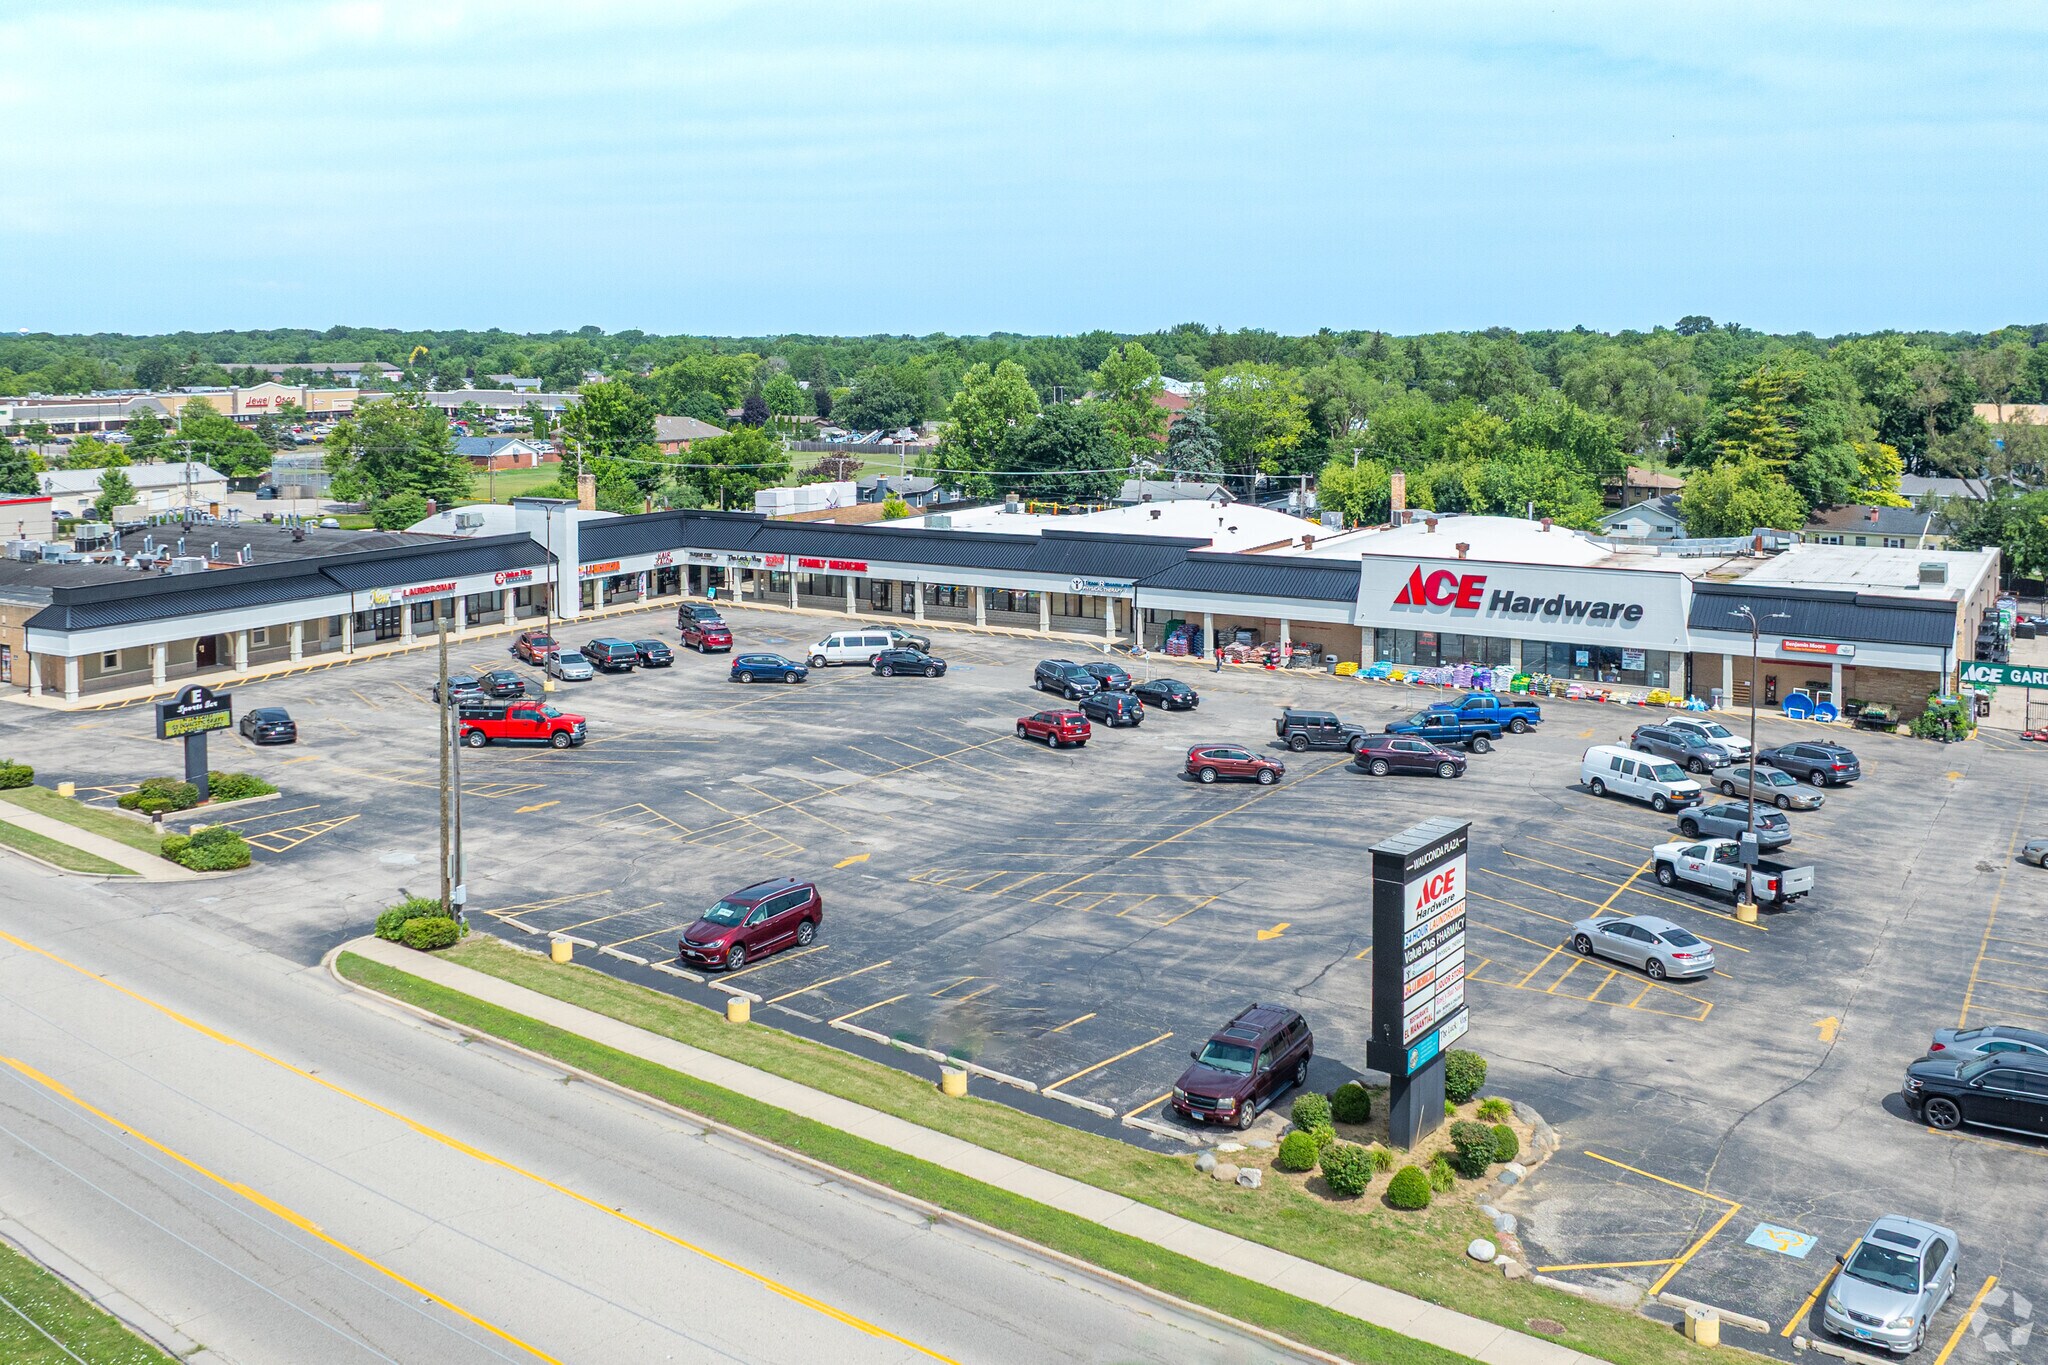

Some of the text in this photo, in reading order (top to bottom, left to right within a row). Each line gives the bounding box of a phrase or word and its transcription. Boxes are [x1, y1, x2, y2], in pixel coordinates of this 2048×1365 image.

[246, 395, 296, 405] Jewel Osco
[798, 557, 868, 572] FAMILY MEDICINE
[403, 582, 457, 597] LAUNDROMAT
[1393, 564, 1644, 622] ACE Hardware
[1961, 664, 2004, 683] ACE
[191, 689, 202, 703] E
[177, 700, 218, 715] Sports Bar
[1413, 838, 1460, 870] WAUCONDA PLAZA
[1416, 867, 1456, 910] ACE
[1416, 893, 1456, 921] Hardware
[1405, 902, 1465, 947] 24 HOUR LAUNDROMAT
[1404, 916, 1465, 964] Value Plus PHARMACY
[1451, 965, 1464, 980] STORE
[1404, 1029, 1410, 1040] EL
